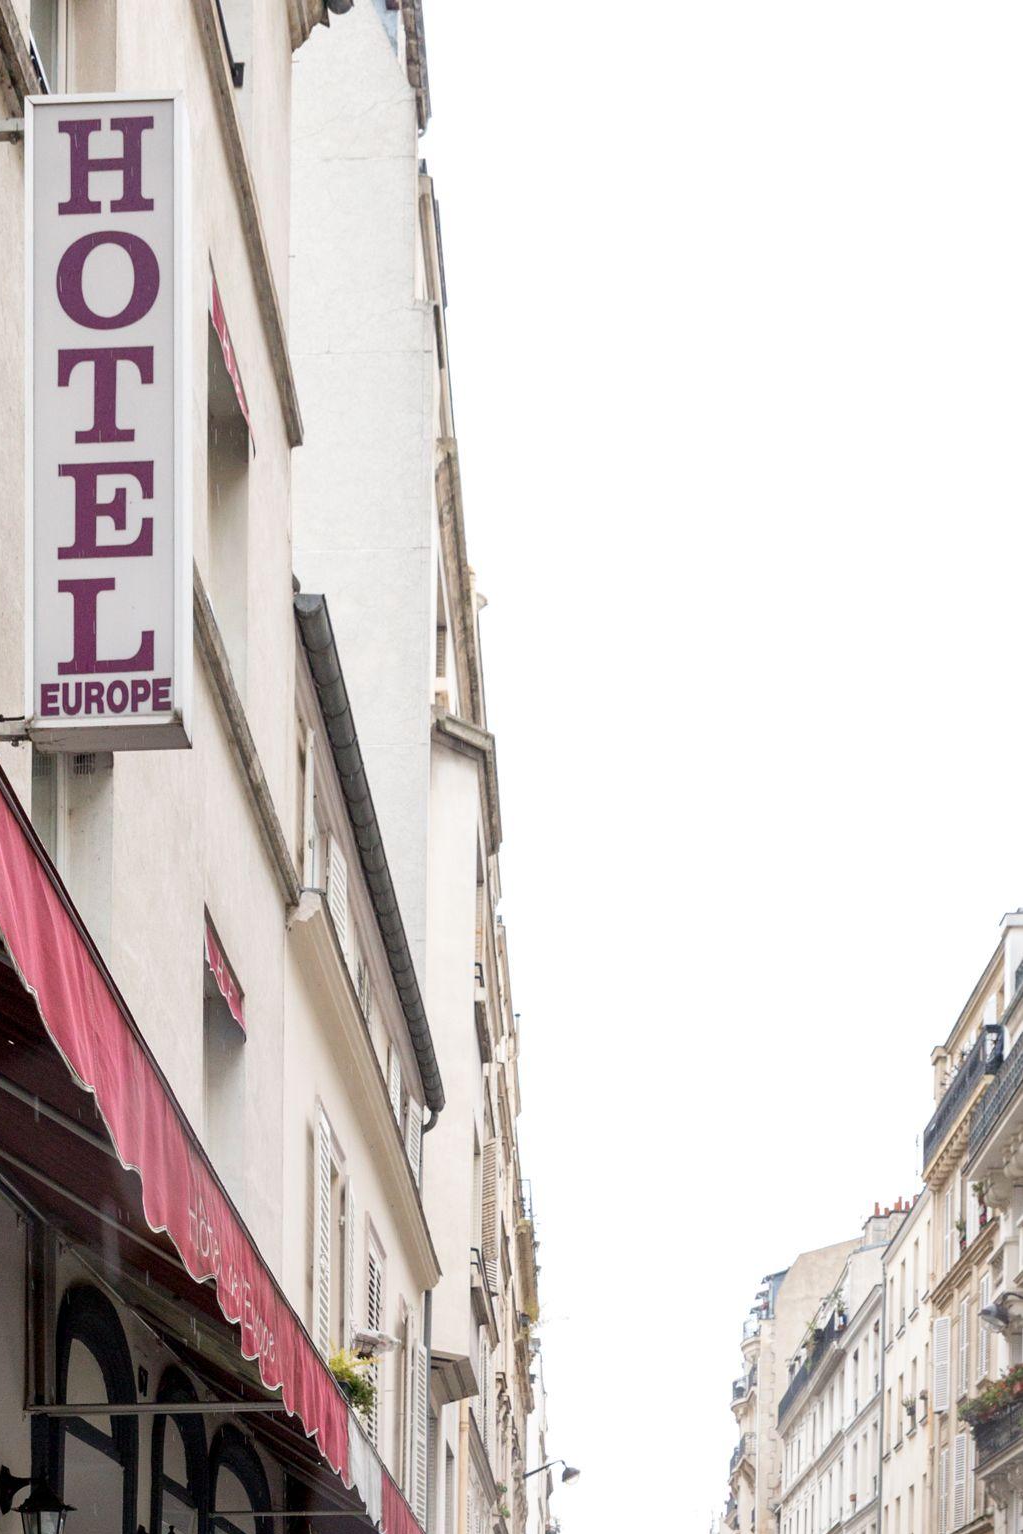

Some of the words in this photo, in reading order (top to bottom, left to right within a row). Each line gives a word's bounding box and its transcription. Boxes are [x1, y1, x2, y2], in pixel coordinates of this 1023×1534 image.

[56, 115, 160, 676] HOTEL
[40, 677, 173, 717] EUROPE
[188, 1187, 223, 1279] Hôtel
